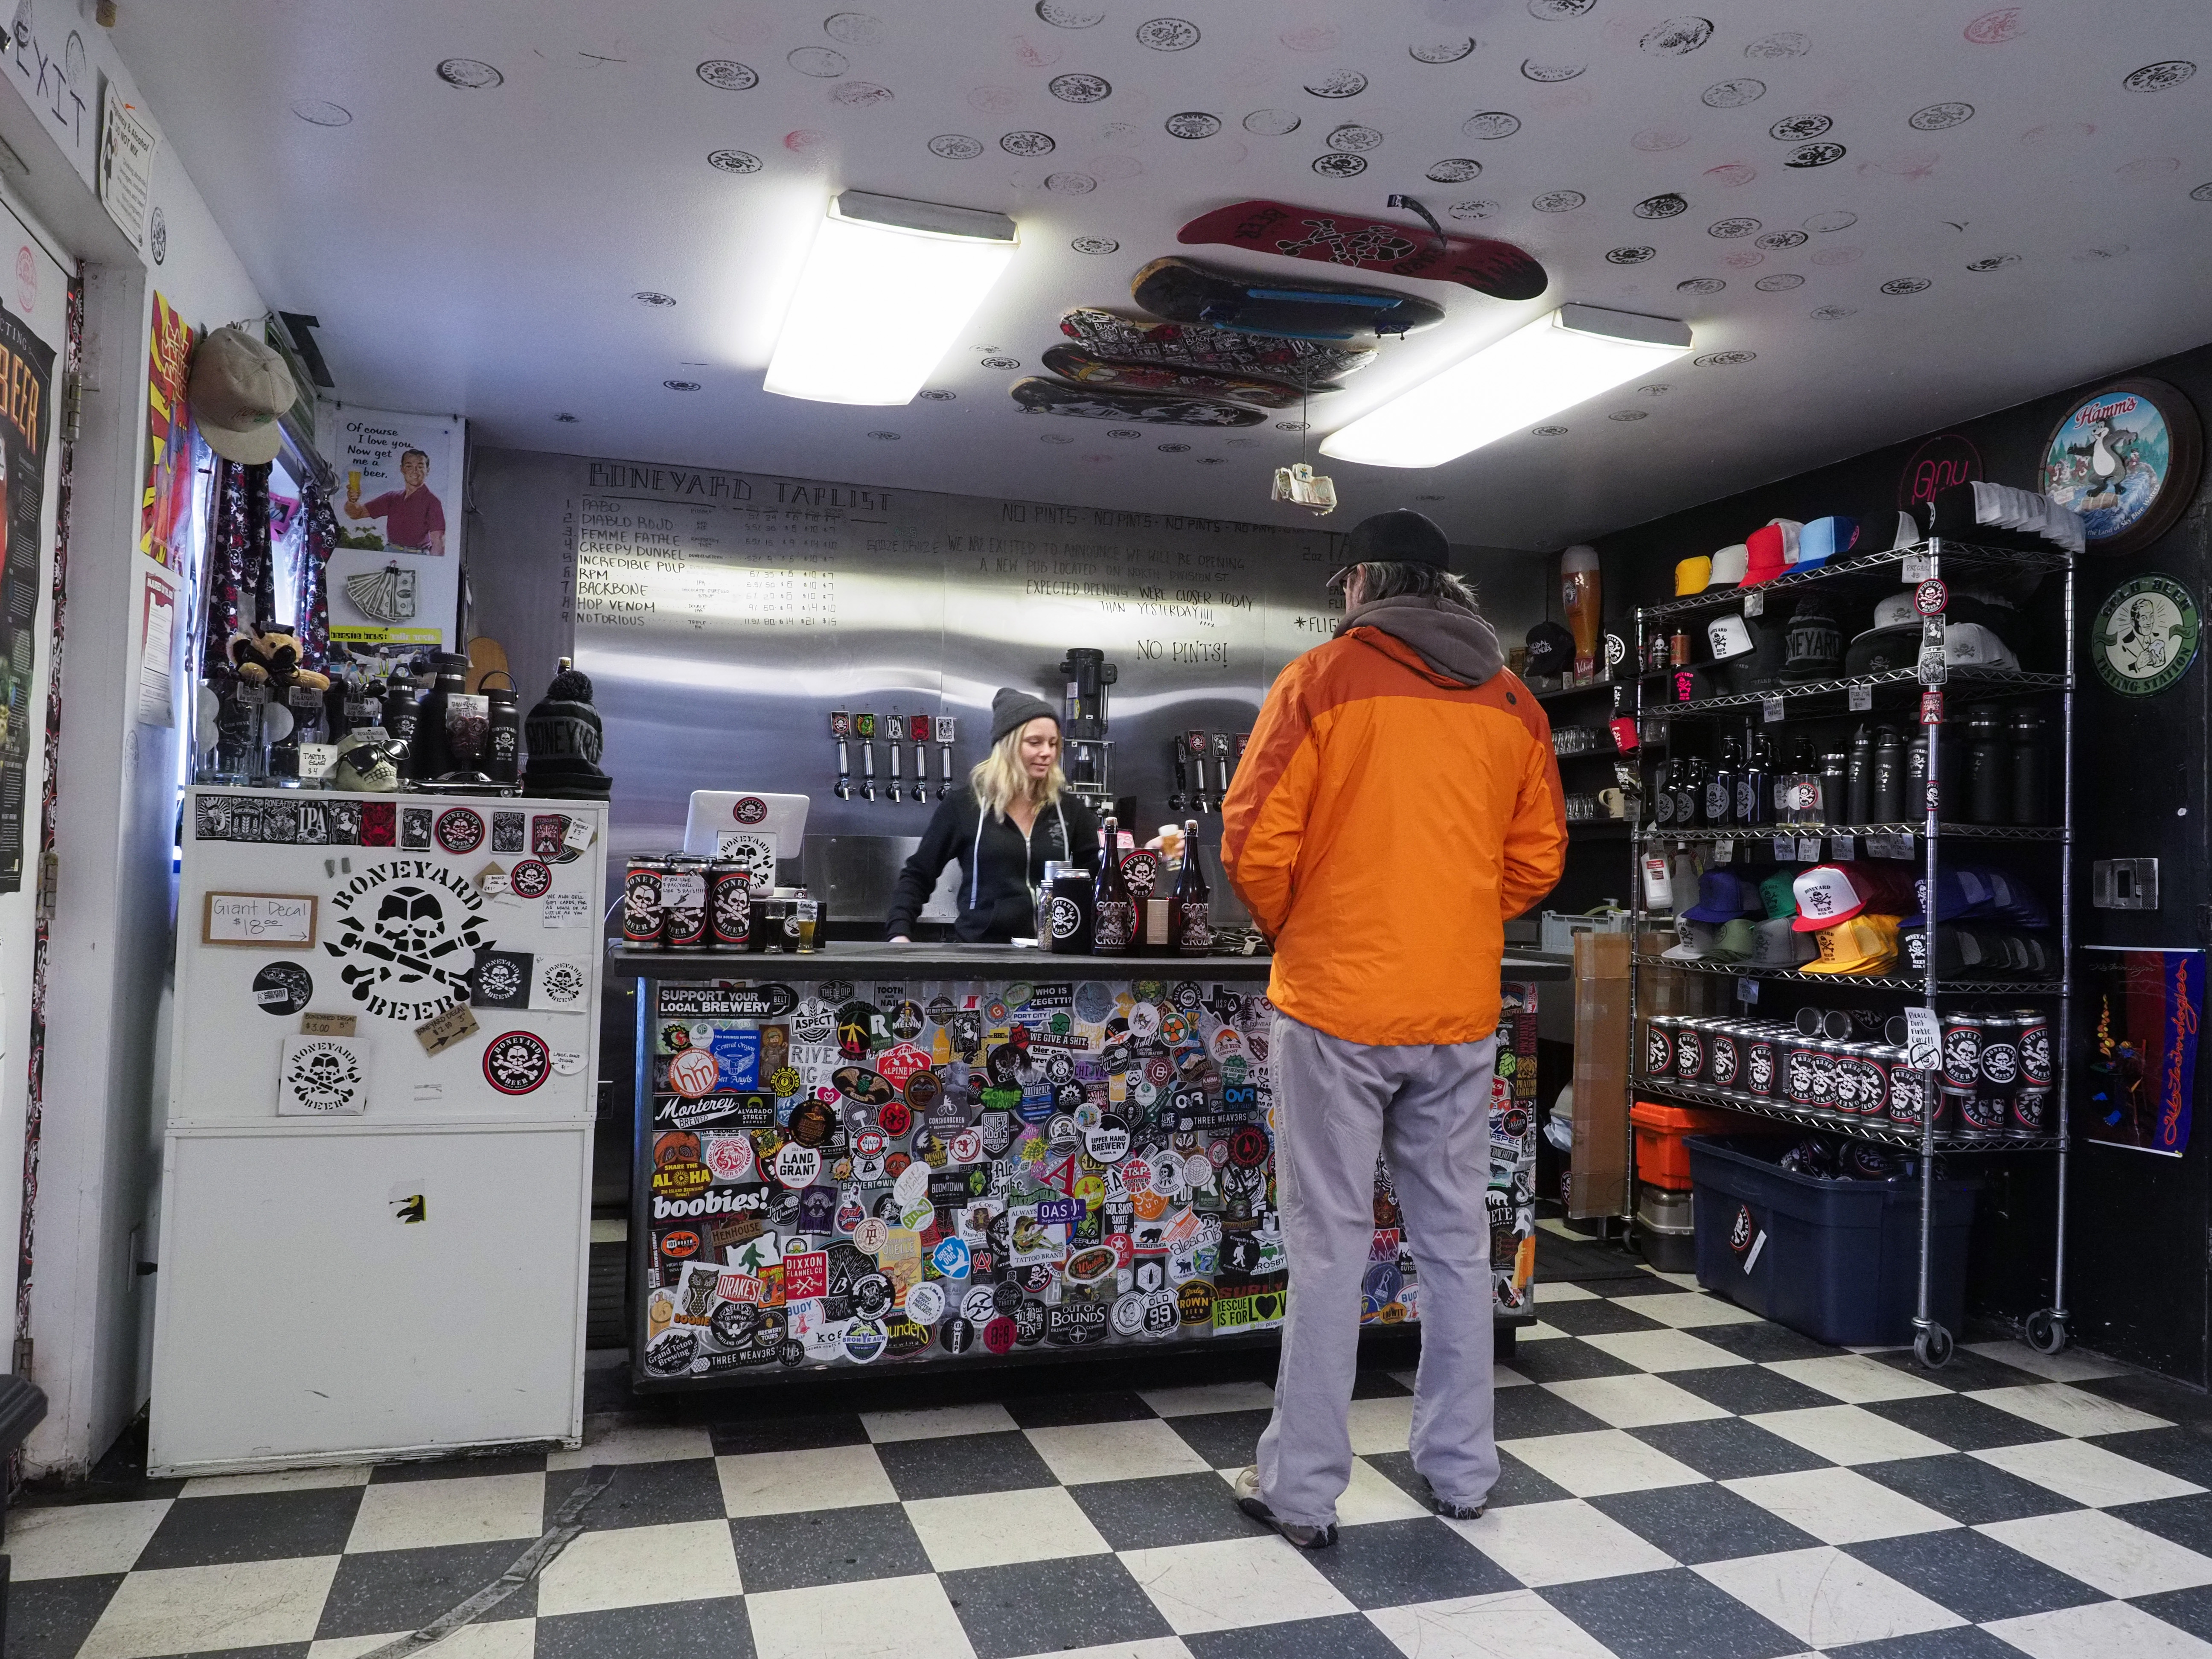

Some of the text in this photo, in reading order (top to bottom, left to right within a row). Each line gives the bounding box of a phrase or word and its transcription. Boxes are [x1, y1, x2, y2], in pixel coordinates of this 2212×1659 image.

[131, 128, 149, 152] Alcohol
[2074, 397, 2138, 429] Hamm's
[347, 423, 398, 436] Of course
[358, 435, 364, 443] I
[367, 435, 387, 445] love
[347, 445, 370, 455] Now
[364, 469, 387, 478] beer.
[589, 463, 892, 511] BONEYARD TAPLIST
[582, 499, 620, 512] PABO
[2098, 526, 2113, 536] Land
[2113, 523, 2120, 532] of
[2120, 515, 2133, 531] Sky
[2131, 503, 2145, 521] Blue
[2142, 483, 2160, 511] Waters
[582, 514, 673, 530] DIABLO ROJO
[581, 528, 680, 546] FEMME FATALE
[579, 541, 685, 560] CREEPY DUNKEL
[580, 555, 651, 570] INCREDIBLE
[657, 562, 685, 573] PULP
[579, 568, 608, 580] RPM
[579, 582, 648, 596] BACKBONE
[1026, 579, 1079, 596] EXPECTED
[1176, 589, 1211, 605] CLOSER
[1220, 592, 1254, 612] TODAY
[2151, 578, 2195, 611] BEER
[577, 597, 655, 612] HOP VENOM
[1099, 600, 1125, 613] THAN
[577, 613, 645, 626] NOTORIOUS
[1137, 639, 1228, 669] NO PINTS!
[2095, 645, 2192, 693] TESTING STATION
[299, 806, 327, 832] IPA
[1124, 855, 1157, 870] BONEYARD
[332, 860, 483, 911] BONEYARD
[1804, 885, 1831, 894] BONEYARD
[214, 899, 306, 916] Giant Decal
[481, 959, 520, 972] BONEYARD
[545, 963, 582, 978] BONEYARD
[488, 991, 511, 1000] BEER
[661, 990, 759, 1001] SUPPORT YOUR
[821, 987, 851, 997] THE DIP
[877, 986, 903, 995] TOOTH
[1035, 987, 1055, 995] WHO
[552, 995, 573, 1003] BEER
[1031, 996, 1072, 1006] ZEGETTI?
[366, 994, 455, 1021] BEER
[661, 1001, 771, 1013] LOCAL BREWERY
[306, 1022, 329, 1033] $3.00
[795, 1016, 831, 1030] ASPECT
[892, 1021, 921, 1029] MELVIN
[1030, 1033, 1041, 1041] WE
[1043, 1033, 1061, 1043] GIVE
[1063, 1036, 1068, 1044] A
[493, 1037, 543, 1054] BONEYARD
[504, 1077, 529, 1086] BEER
[655, 1096, 740, 1121] Monterey
[679, 1115, 708, 1128] BREWED
[929, 1116, 965, 1124] CONSHOHOCKEN
[1508, 1119, 1525, 1129] JAGGED
[1091, 1142, 1126, 1152] BREWERY
[783, 1152, 813, 1164] LAND
[780, 1164, 816, 1176] GRANT
[931, 1182, 964, 1193] BOOMTOWN
[653, 1186, 768, 1219] boobies!
[1112, 1215, 1128, 1224] SKATE
[1114, 1224, 1127, 1233] SHOP
[937, 1243, 953, 1262] BREW
[943, 1252, 956, 1265] DOG
[1015, 1254, 1040, 1263] TATTOO
[786, 1256, 823, 1269] DIXXON
[787, 1267, 813, 1277] FLANNEL
[719, 1275, 760, 1301] DRAKE'S
[1149, 1294, 1169, 1306] OLD
[1217, 1298, 1247, 1312] RESCUE
[1063, 1306, 1081, 1314] OUT
[1150, 1305, 1171, 1325] 99
[1051, 1307, 1105, 1327] BOUNDS
[1217, 1310, 1247, 1326] IS FOR
[758, 1327, 782, 1336] BREWERY
[647, 1339, 693, 1364] Grand Teton
[658, 1349, 690, 1366] Brewing
[712, 1347, 775, 1365] THREE WEAV3RS
